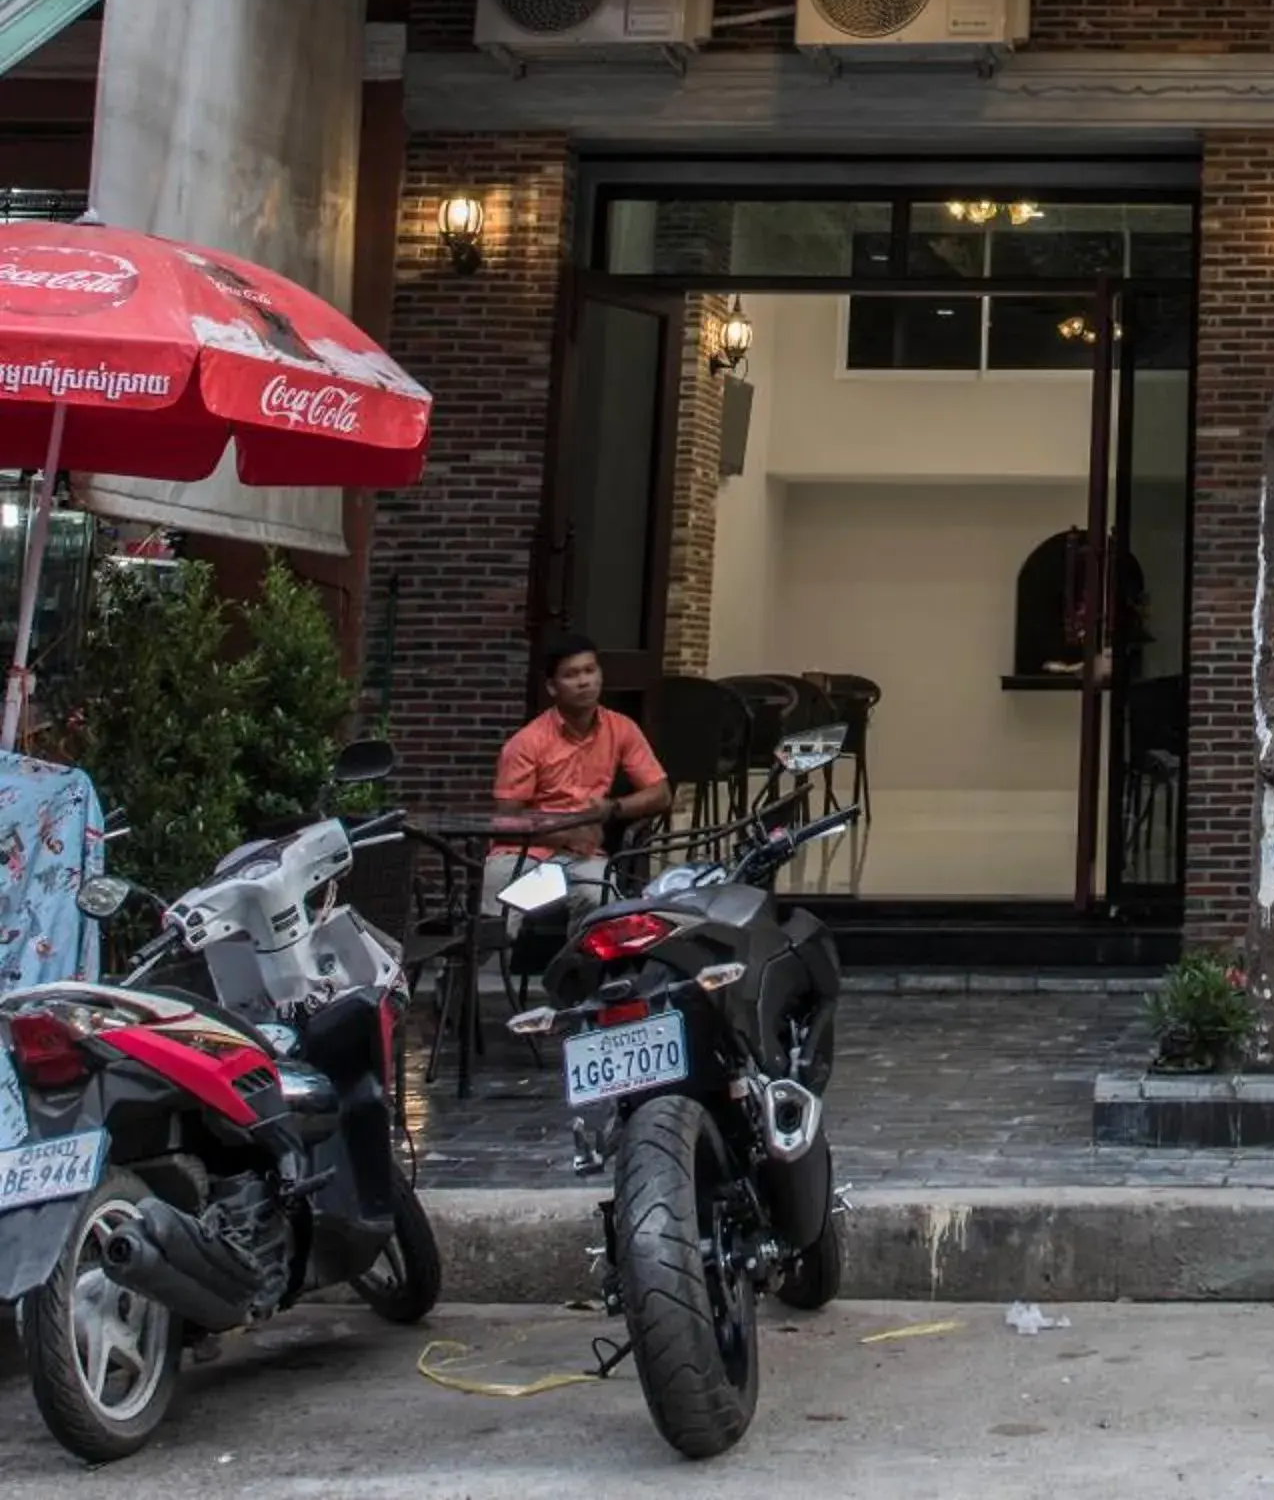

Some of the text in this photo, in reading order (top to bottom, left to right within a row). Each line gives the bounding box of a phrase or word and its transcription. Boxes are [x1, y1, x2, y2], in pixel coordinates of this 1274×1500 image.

[260, 374, 363, 434] Coca-Cola
[571, 1040, 680, 1093] 1GG-7070
[0, 1154, 94, 1196] BE-9464
